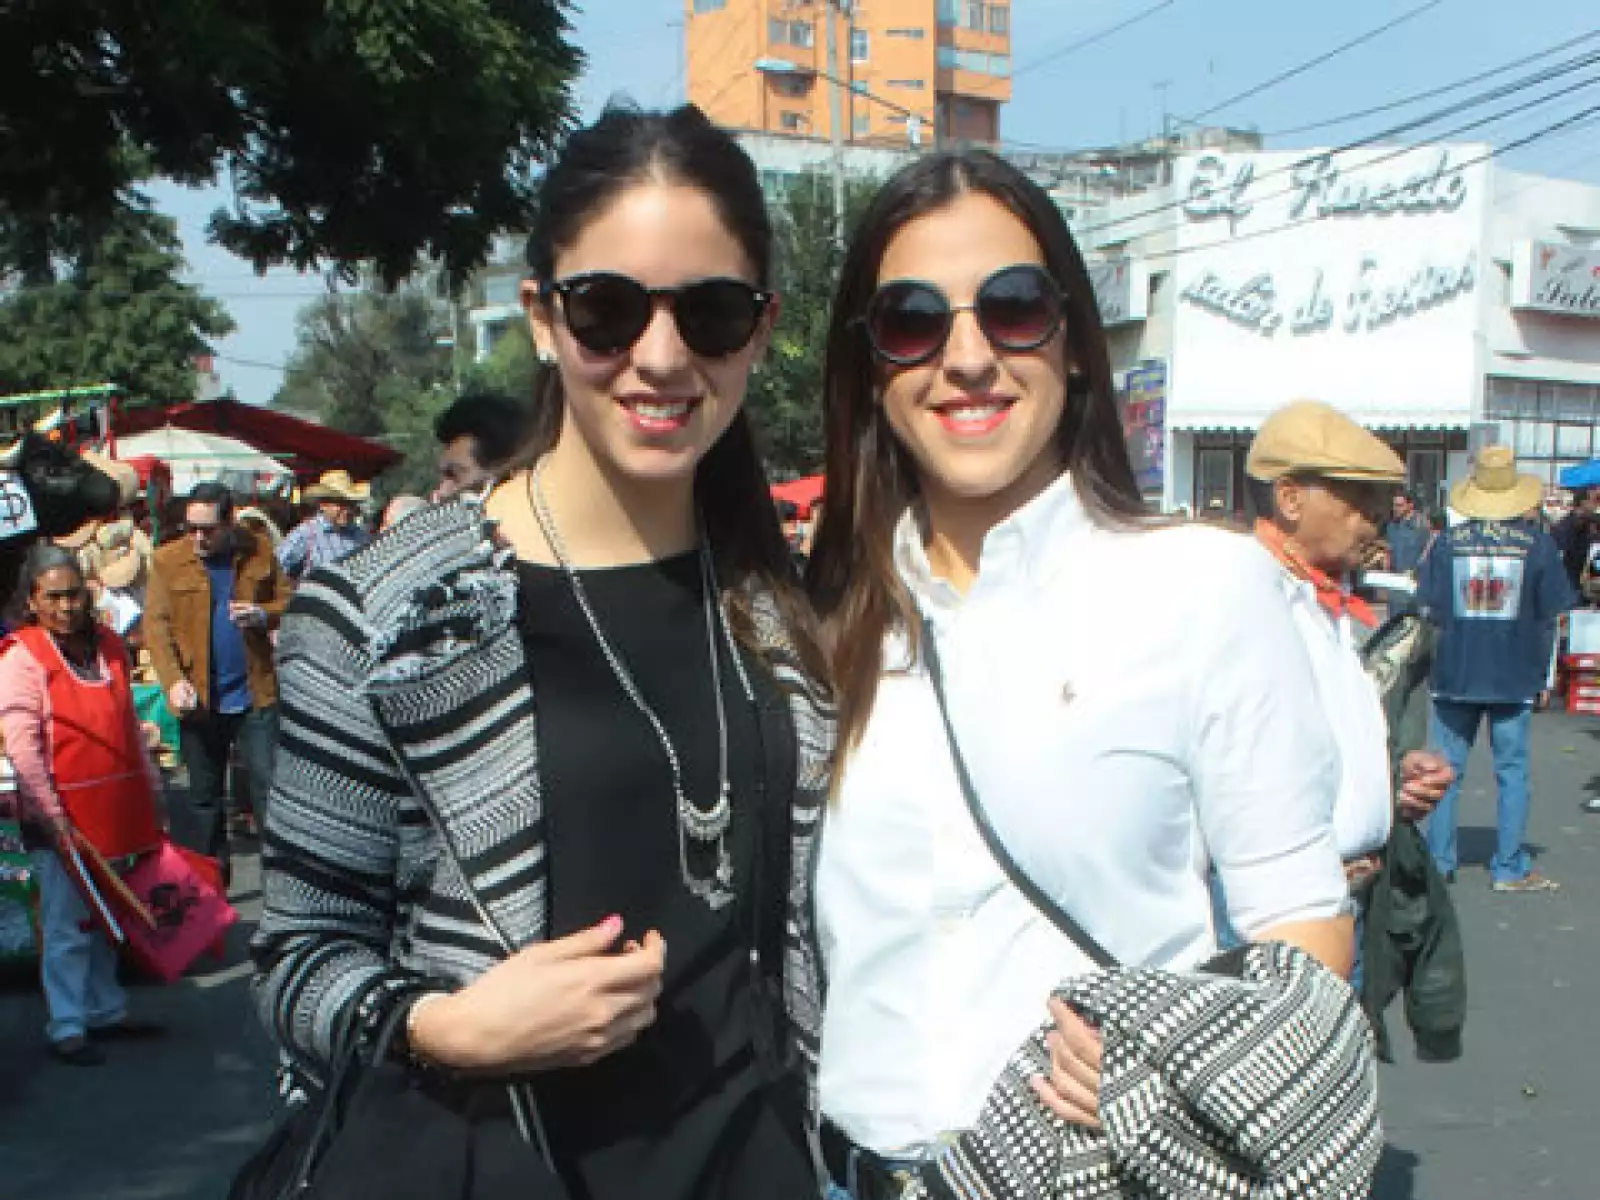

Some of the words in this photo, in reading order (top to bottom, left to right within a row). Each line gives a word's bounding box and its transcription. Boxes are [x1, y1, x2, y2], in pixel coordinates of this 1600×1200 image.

[1182, 153, 1255, 229] El
[1289, 150, 1469, 219] Ruedo
[1290, 265, 1335, 337] de
